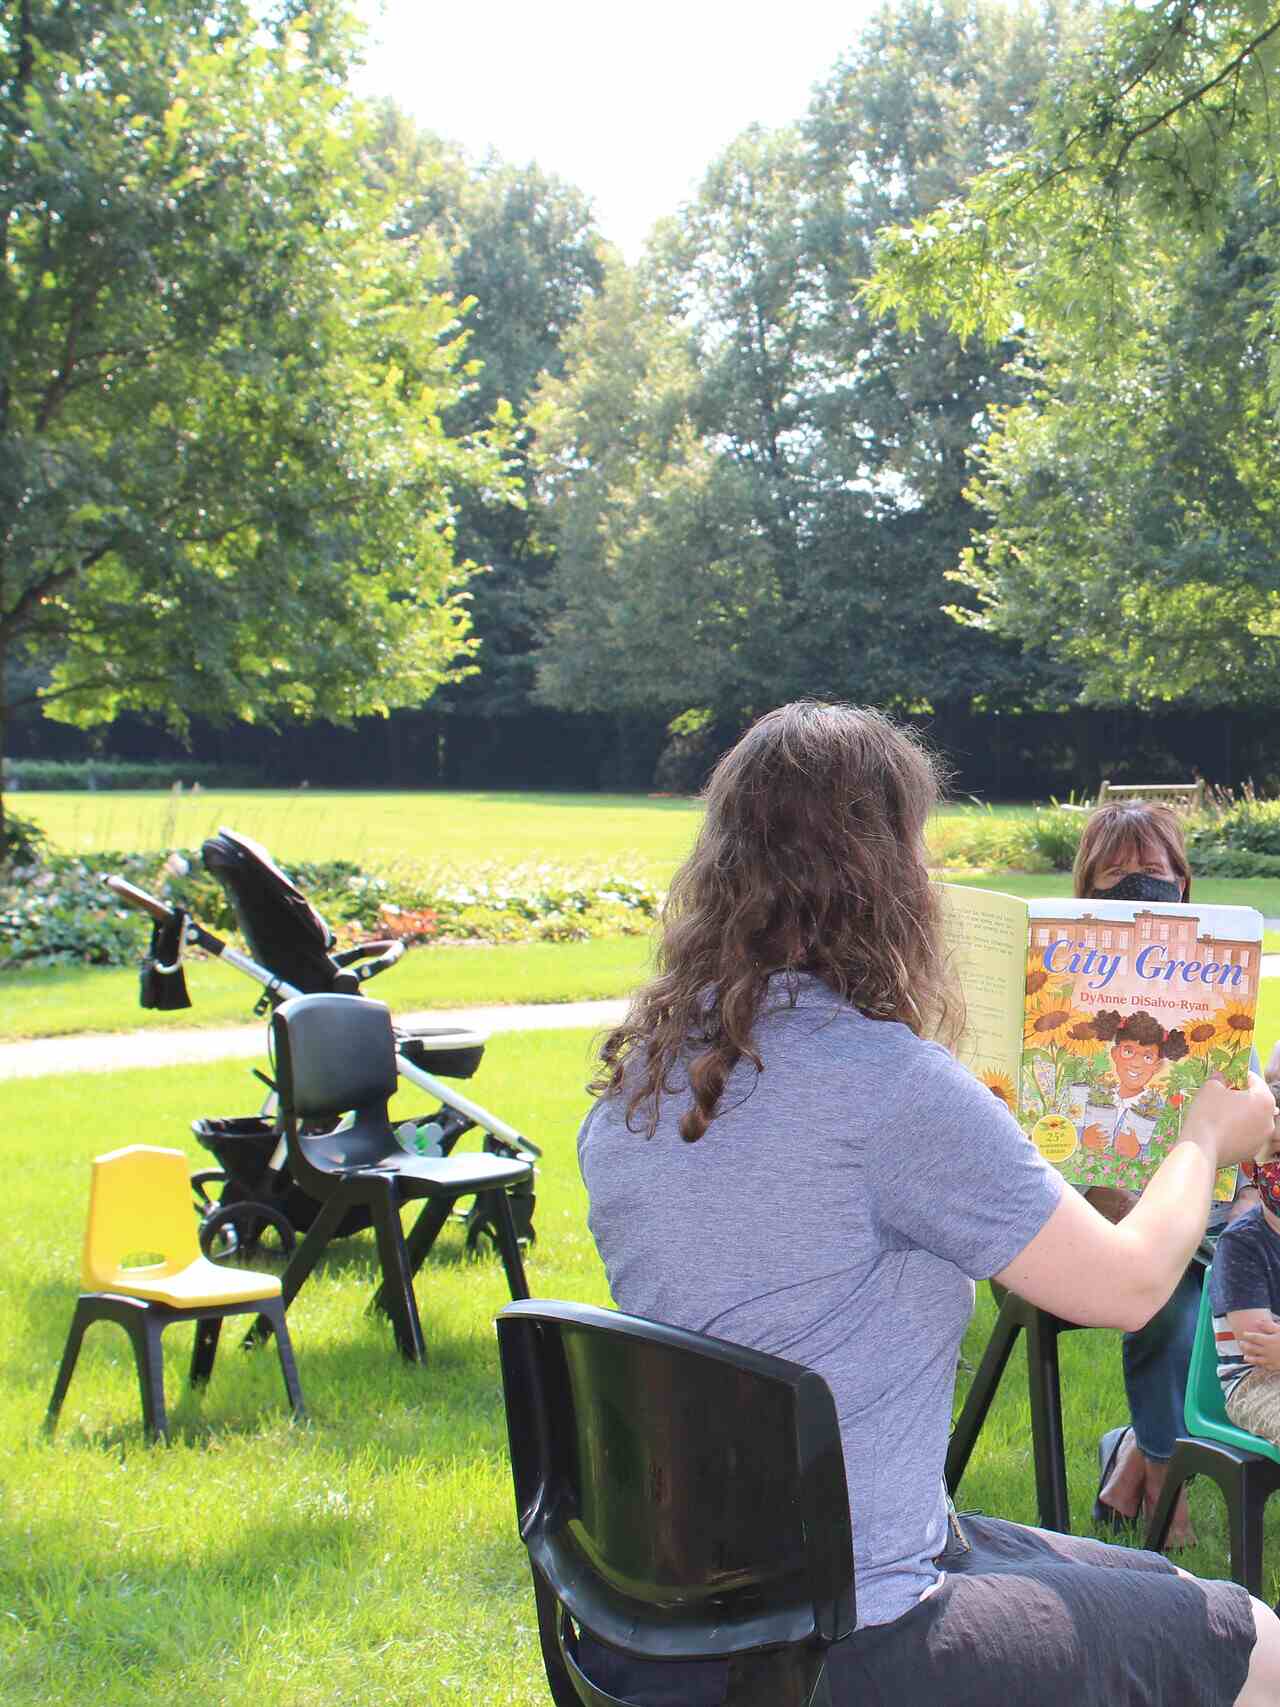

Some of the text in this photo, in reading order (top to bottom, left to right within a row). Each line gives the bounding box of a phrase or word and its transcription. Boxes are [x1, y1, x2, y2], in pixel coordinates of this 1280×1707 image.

[1043, 939, 1122, 989] City
[1135, 944, 1243, 986] Green
[1080, 991, 1209, 1013] DyAnne DiSalvo-Ryan
